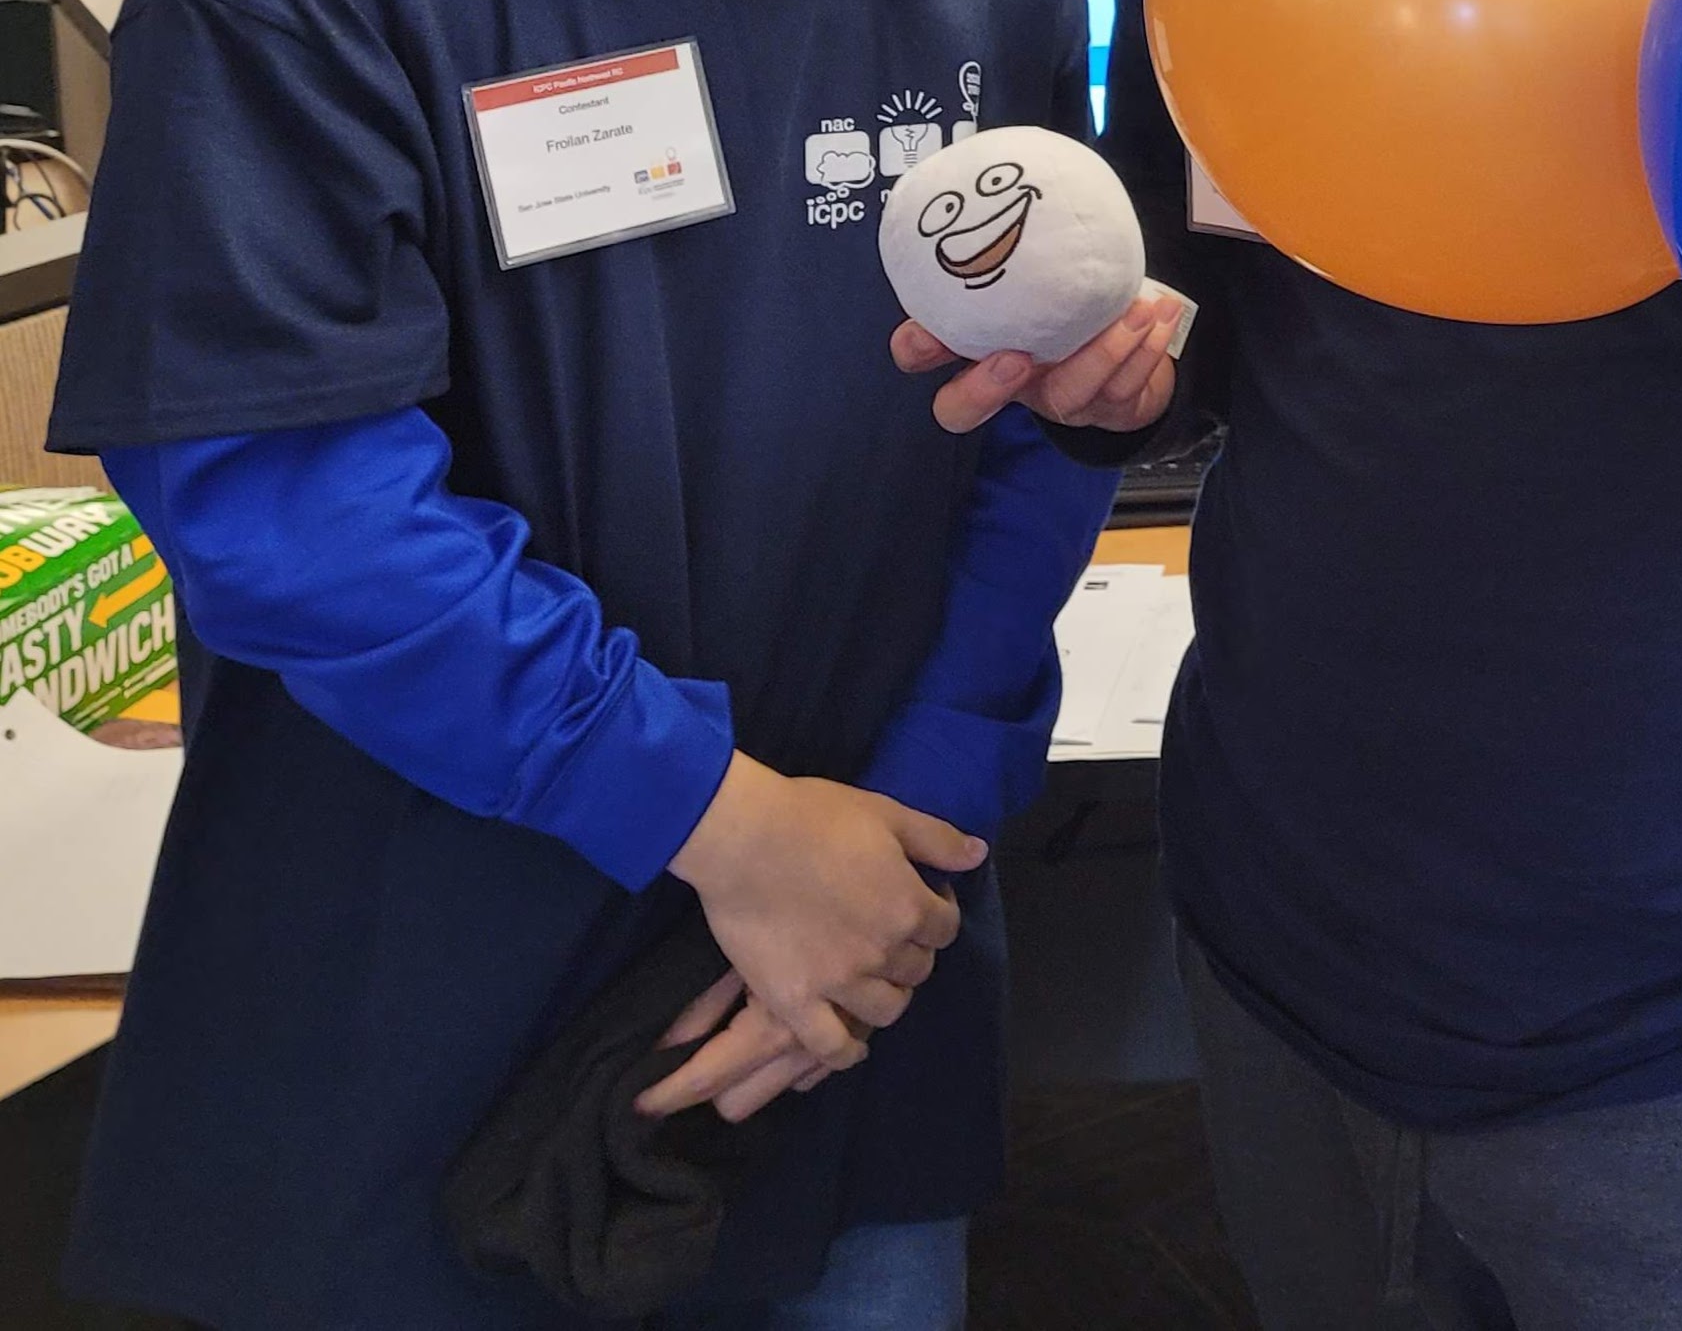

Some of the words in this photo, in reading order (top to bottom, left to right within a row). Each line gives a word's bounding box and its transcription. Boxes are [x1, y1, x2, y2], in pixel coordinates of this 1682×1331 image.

[558, 96, 610, 115] Contestant
[545, 132, 590, 153] Froilan
[592, 122, 633, 142] Zarate
[820, 116, 855, 133] nac
[574, 183, 611, 198] University
[805, 199, 865, 229] icpc
[0, 501, 113, 590] UBWAY
[0, 573, 86, 645] MEBODY'S
[86, 548, 120, 590] GOT
[0, 600, 86, 697] ASTY
[32, 593, 176, 716] NDWICH
